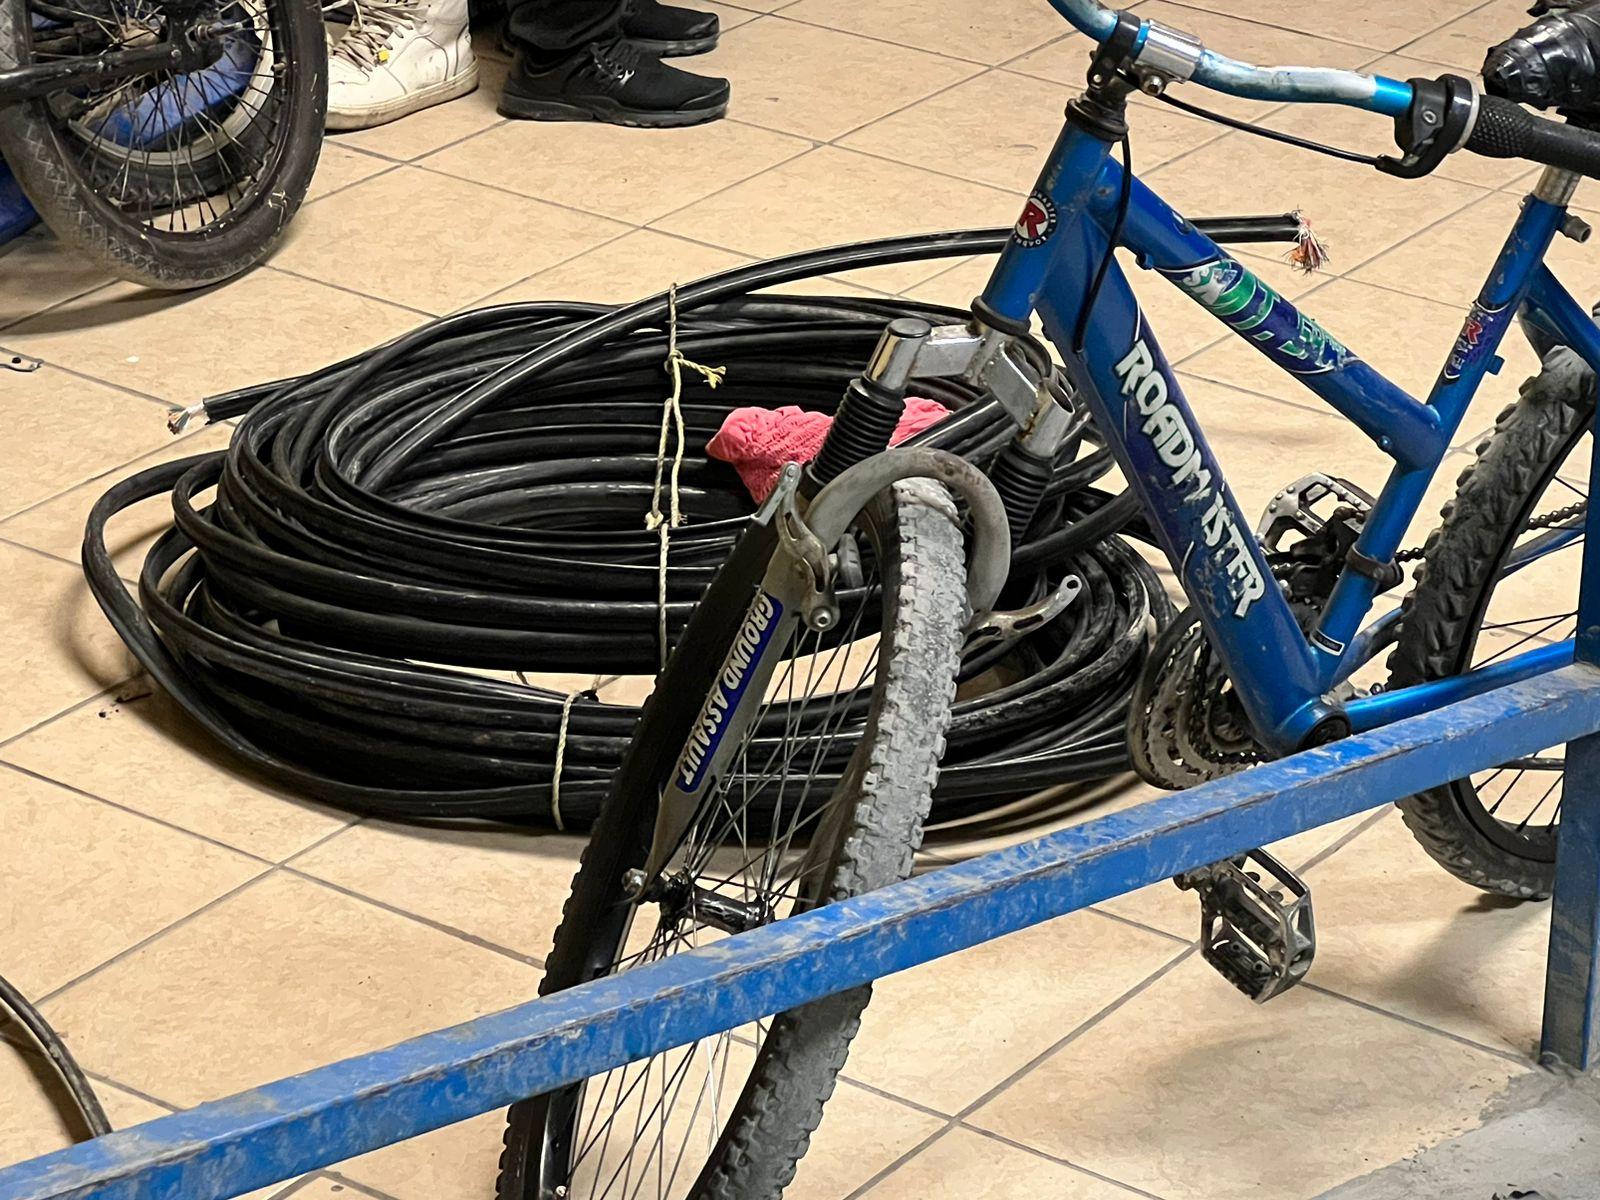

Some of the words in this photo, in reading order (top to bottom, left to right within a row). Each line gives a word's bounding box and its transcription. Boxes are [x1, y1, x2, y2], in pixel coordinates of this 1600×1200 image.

[1018, 200, 1047, 239] R
[723, 593, 774, 690] GROUND
[681, 682, 729, 786] ASSAULT
